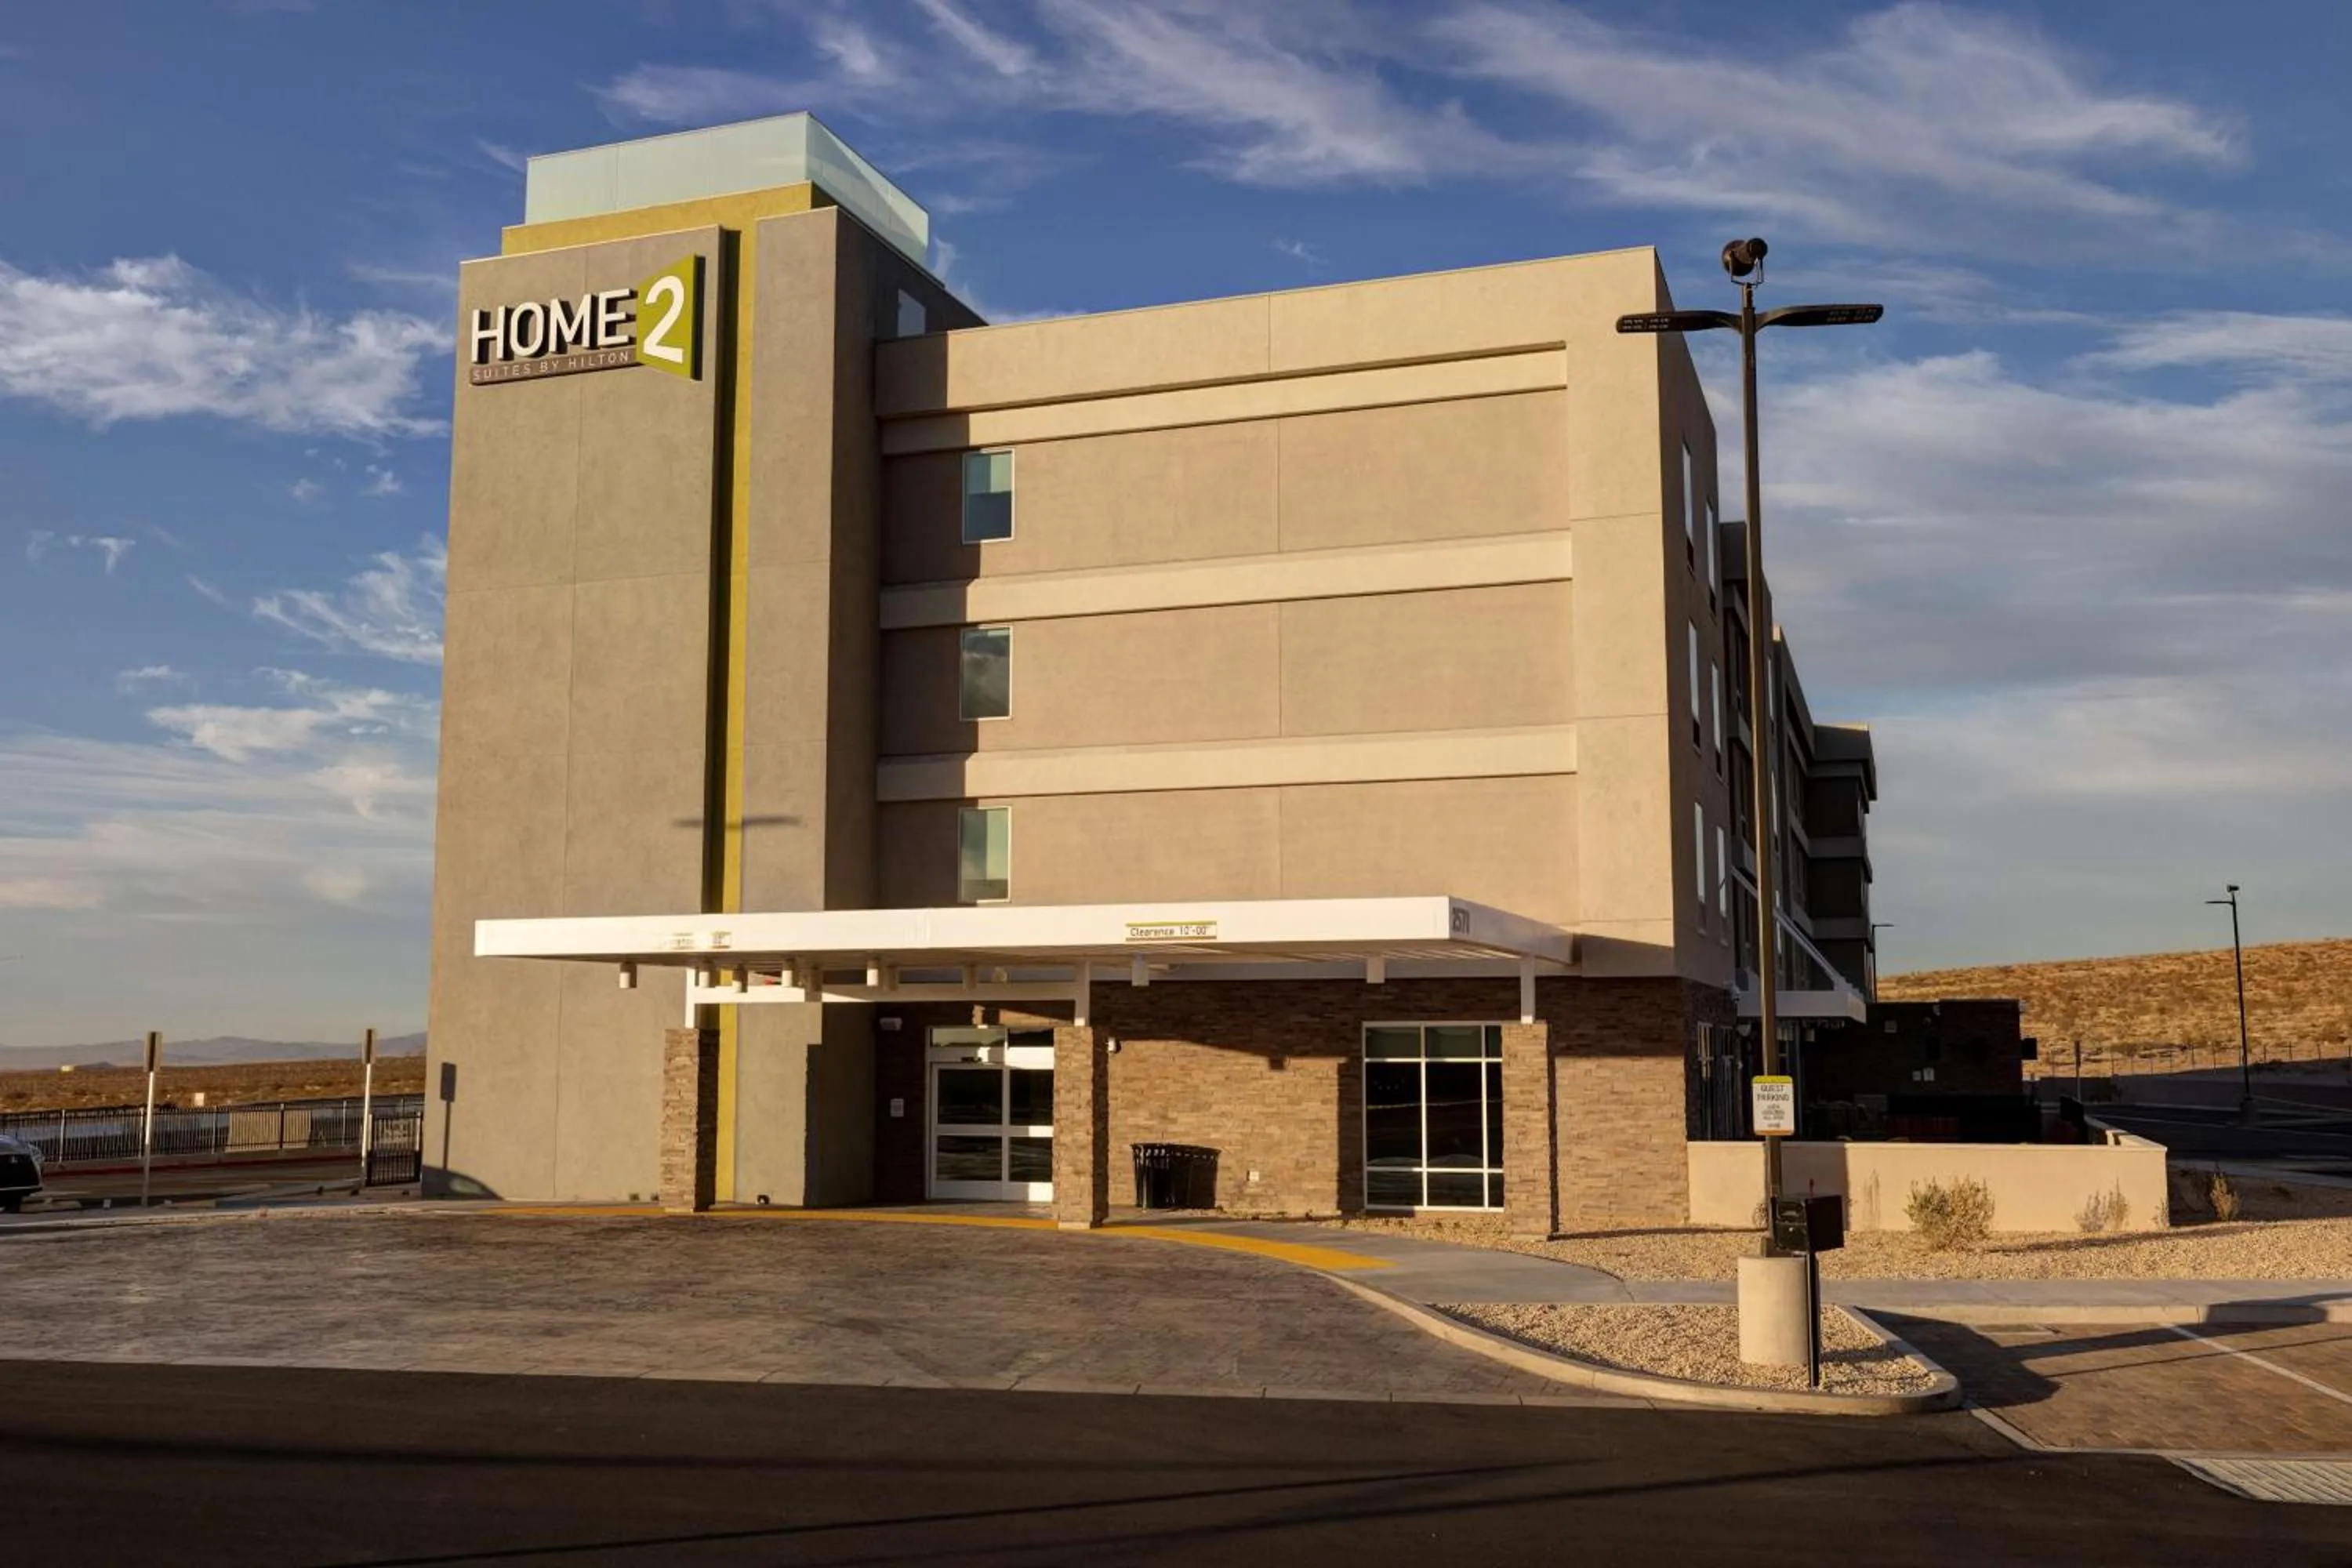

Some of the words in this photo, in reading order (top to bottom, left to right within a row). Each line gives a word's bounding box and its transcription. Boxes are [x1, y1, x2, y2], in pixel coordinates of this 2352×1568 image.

[473, 363, 532, 380] SUITES
[539, 361, 559, 373] BY
[568, 351, 628, 368] HILTON
